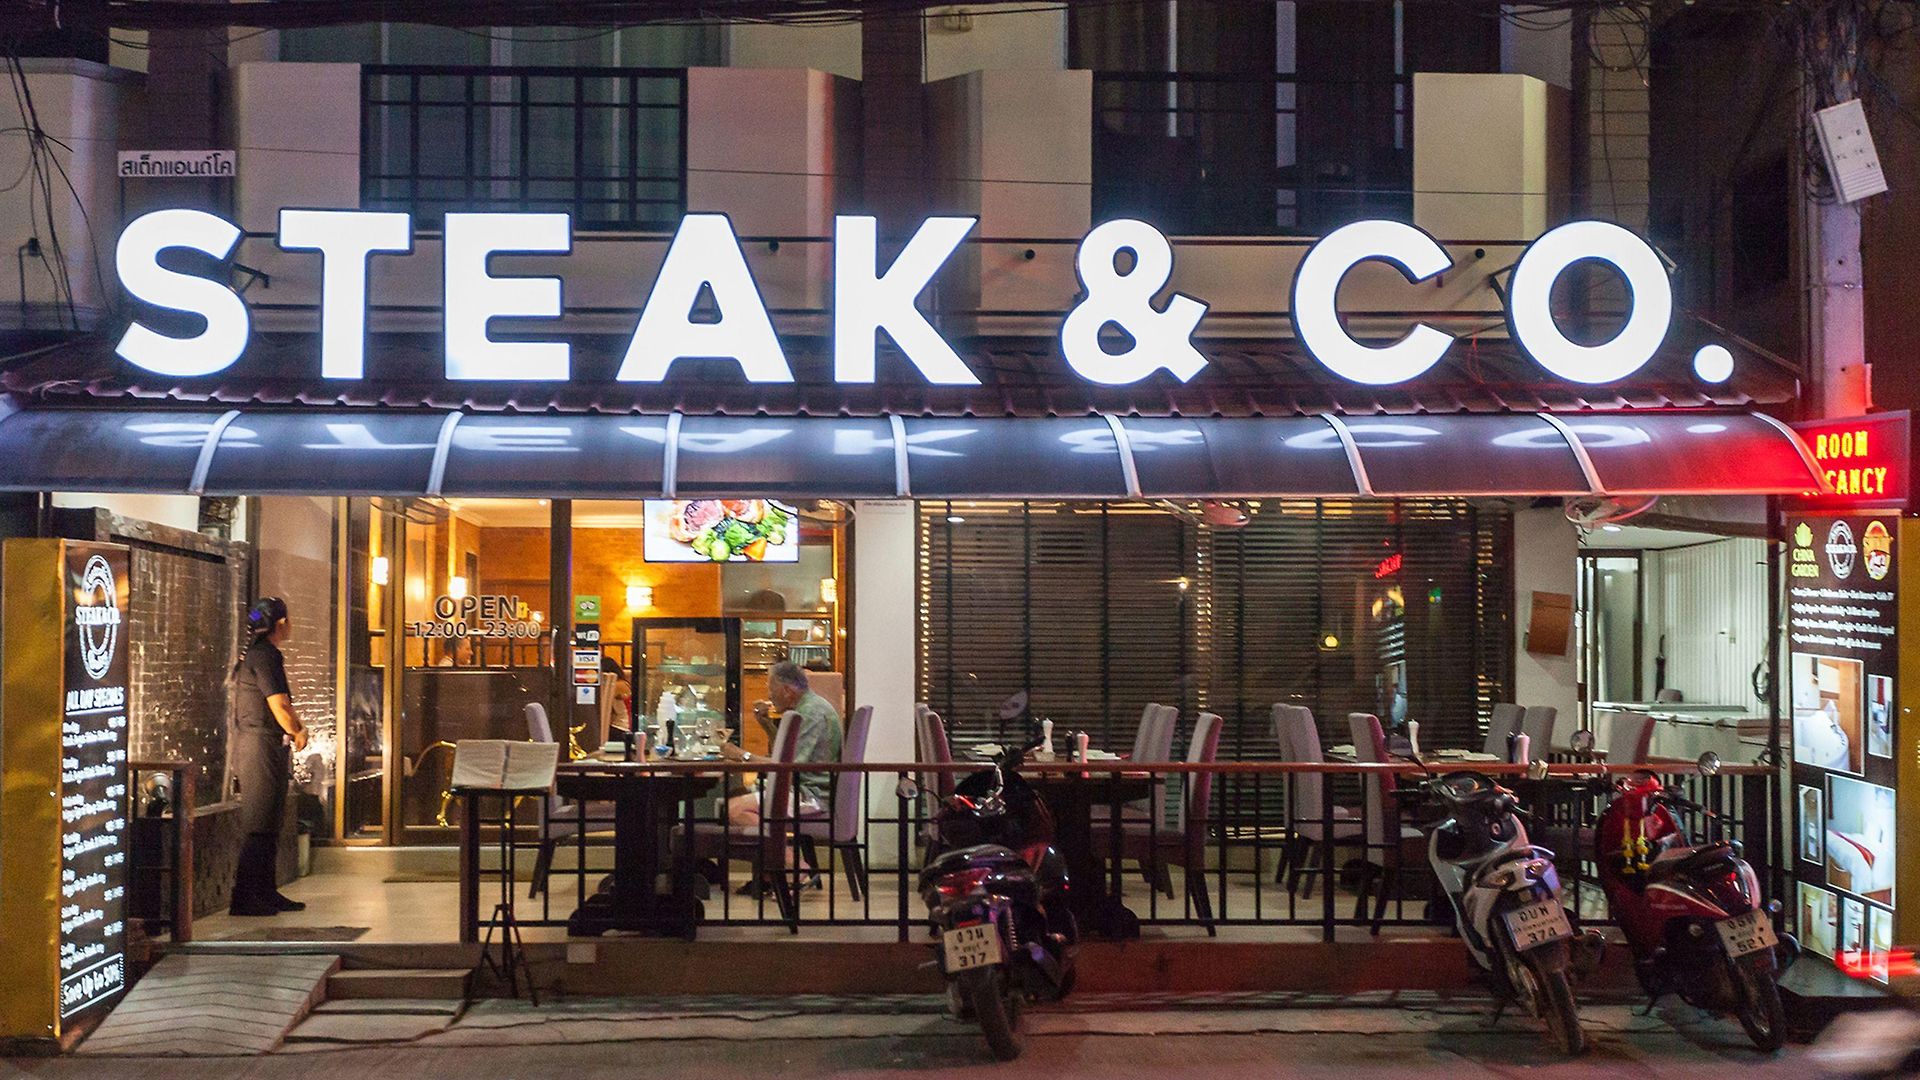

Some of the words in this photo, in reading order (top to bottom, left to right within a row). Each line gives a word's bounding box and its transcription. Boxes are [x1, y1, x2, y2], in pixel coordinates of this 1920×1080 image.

[114, 207, 984, 386] STEAK
[1060, 217, 1211, 386] &
[1292, 219, 1736, 386] CO.
[1816, 430, 1868, 459] ROOM
[434, 595, 520, 621] OPEN
[413, 621, 468, 639] 12:00
[484, 621, 542, 639] 23:00
[1527, 926, 1558, 944] 374
[958, 952, 986, 968] 317
